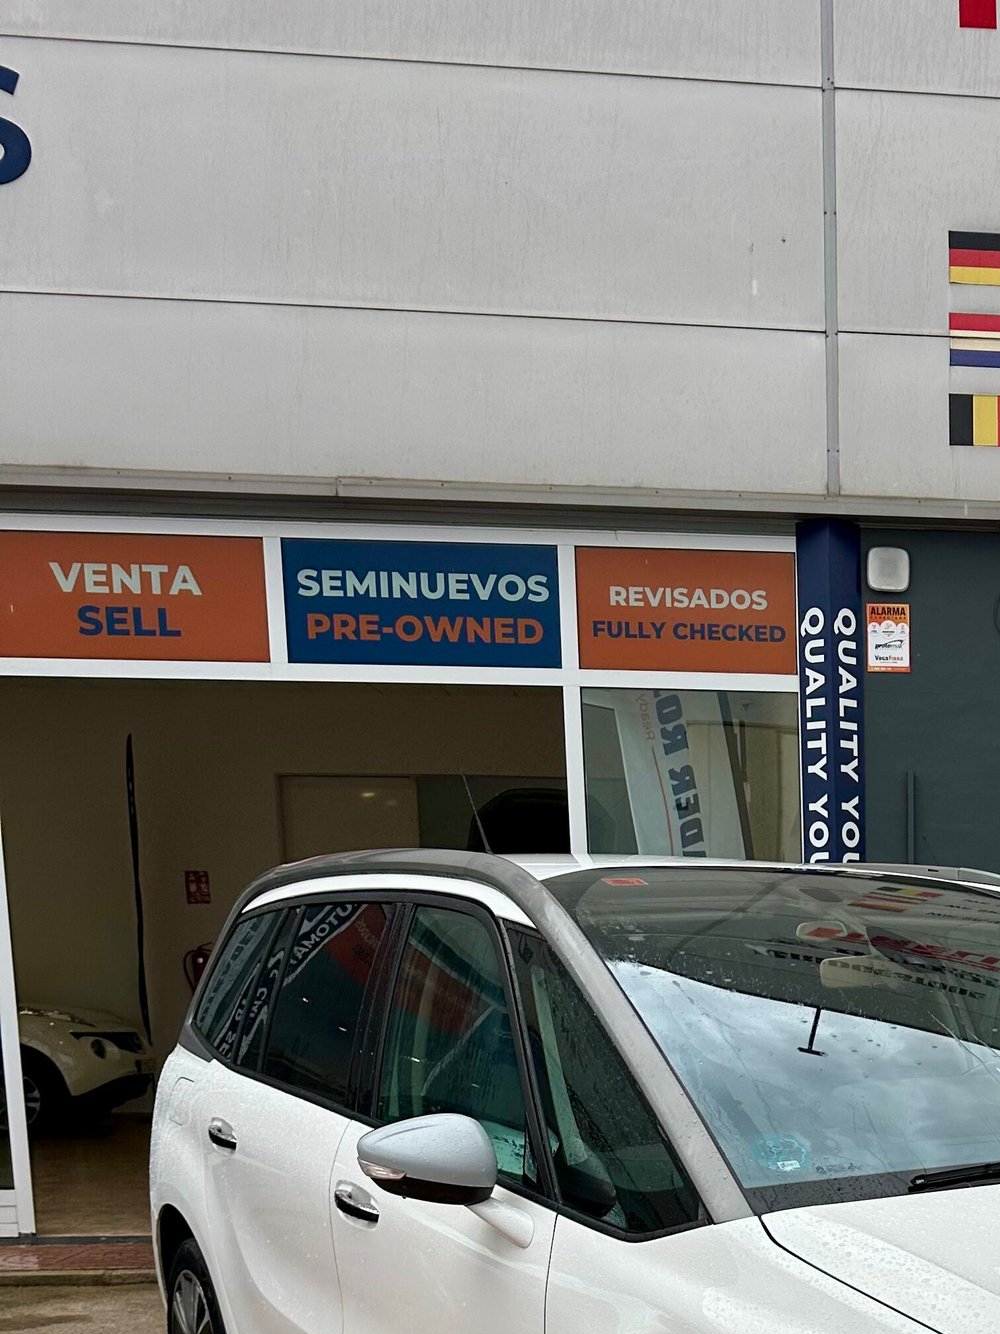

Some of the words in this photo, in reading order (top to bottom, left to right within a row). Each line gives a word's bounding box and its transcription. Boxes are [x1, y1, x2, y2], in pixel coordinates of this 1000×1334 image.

[48, 562, 202, 596] VENTA
[297, 569, 550, 602] SEMINUEVOS
[609, 586, 769, 611] REVISADOS
[870, 606, 906, 616] ALARMA
[78, 605, 182, 637] SELL
[307, 613, 544, 645] PRE-OWNED
[592, 620, 667, 640] FULLY
[672, 623, 786, 643] CHECKED
[800, 607, 828, 781] QUALITY
[834, 607, 860, 784] QUALITY
